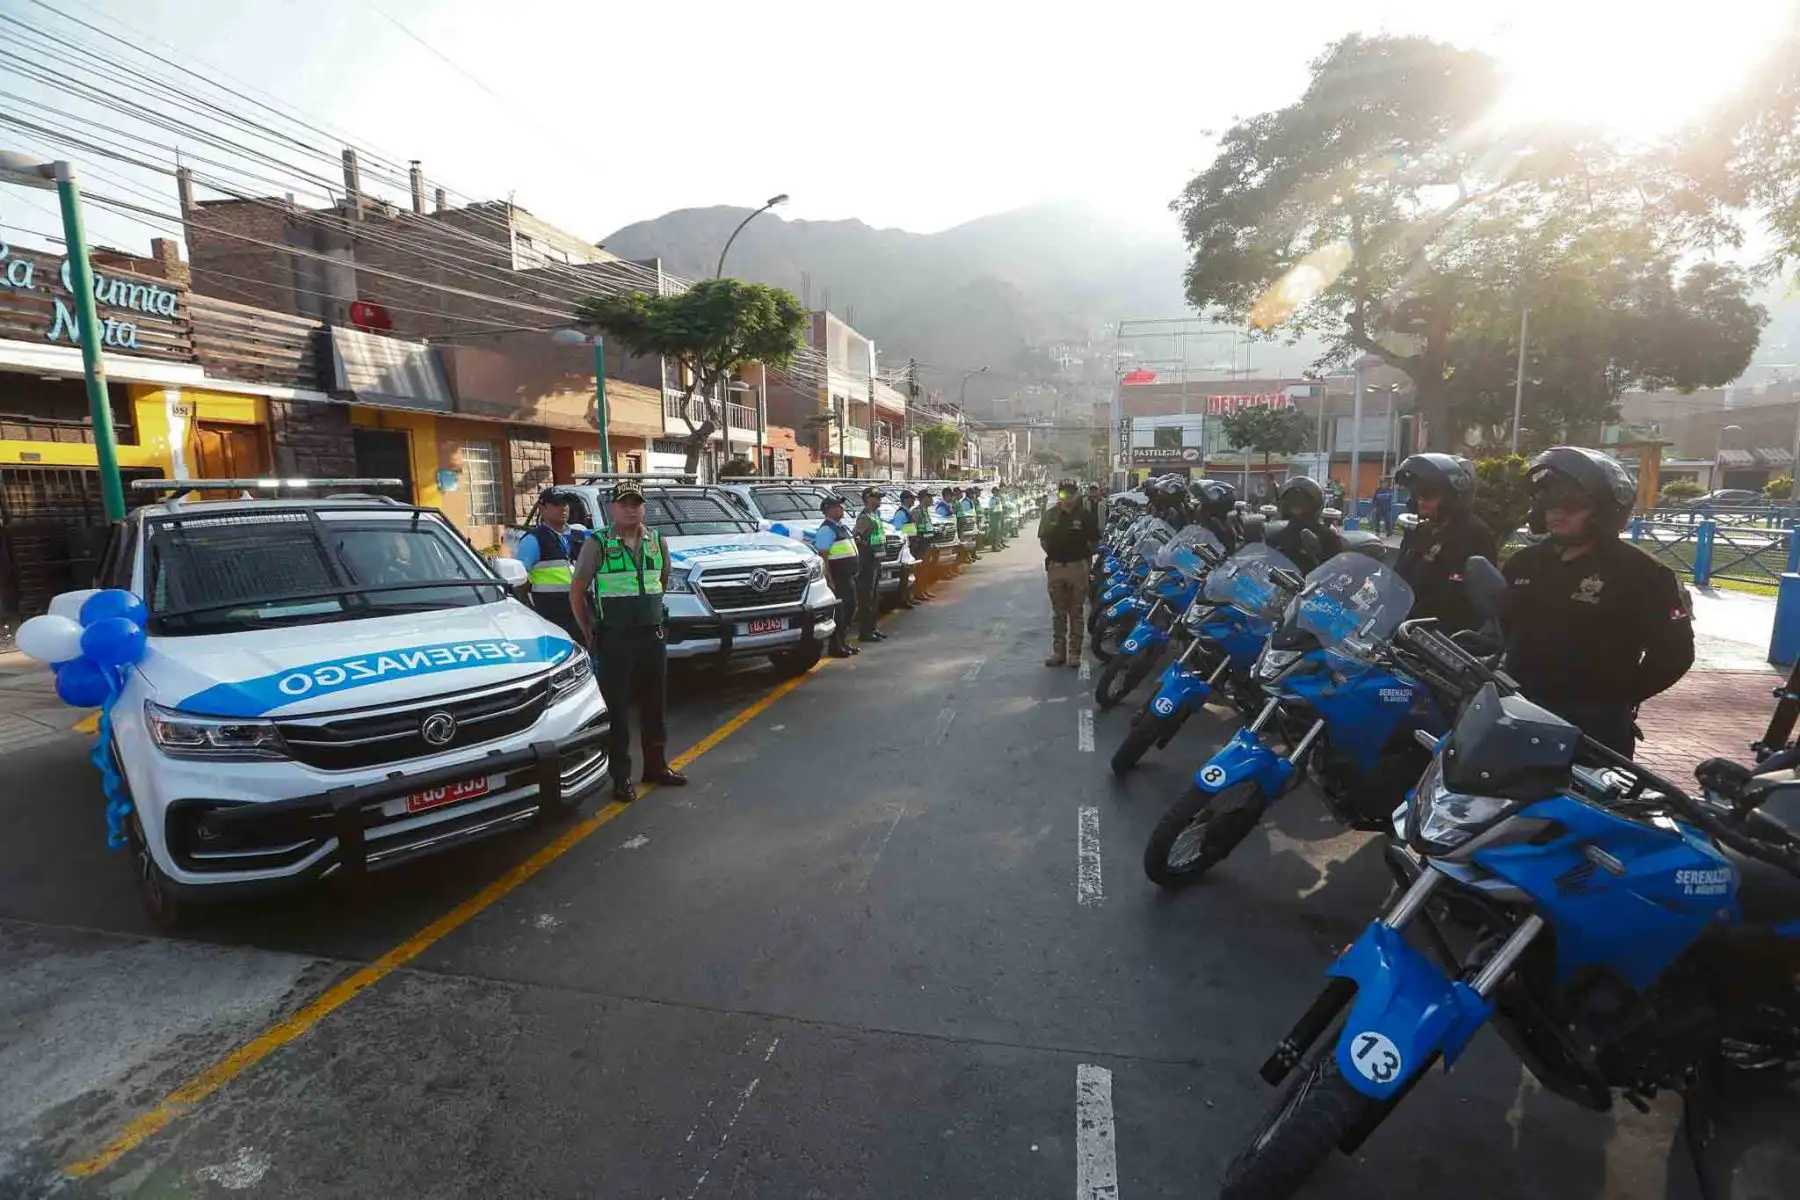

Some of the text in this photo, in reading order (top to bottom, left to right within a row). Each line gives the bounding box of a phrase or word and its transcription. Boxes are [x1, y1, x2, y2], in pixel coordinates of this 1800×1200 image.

[1157, 698, 1173, 713] 15
[1204, 767, 1222, 783] 8
[1356, 1035, 1399, 1080] 13
